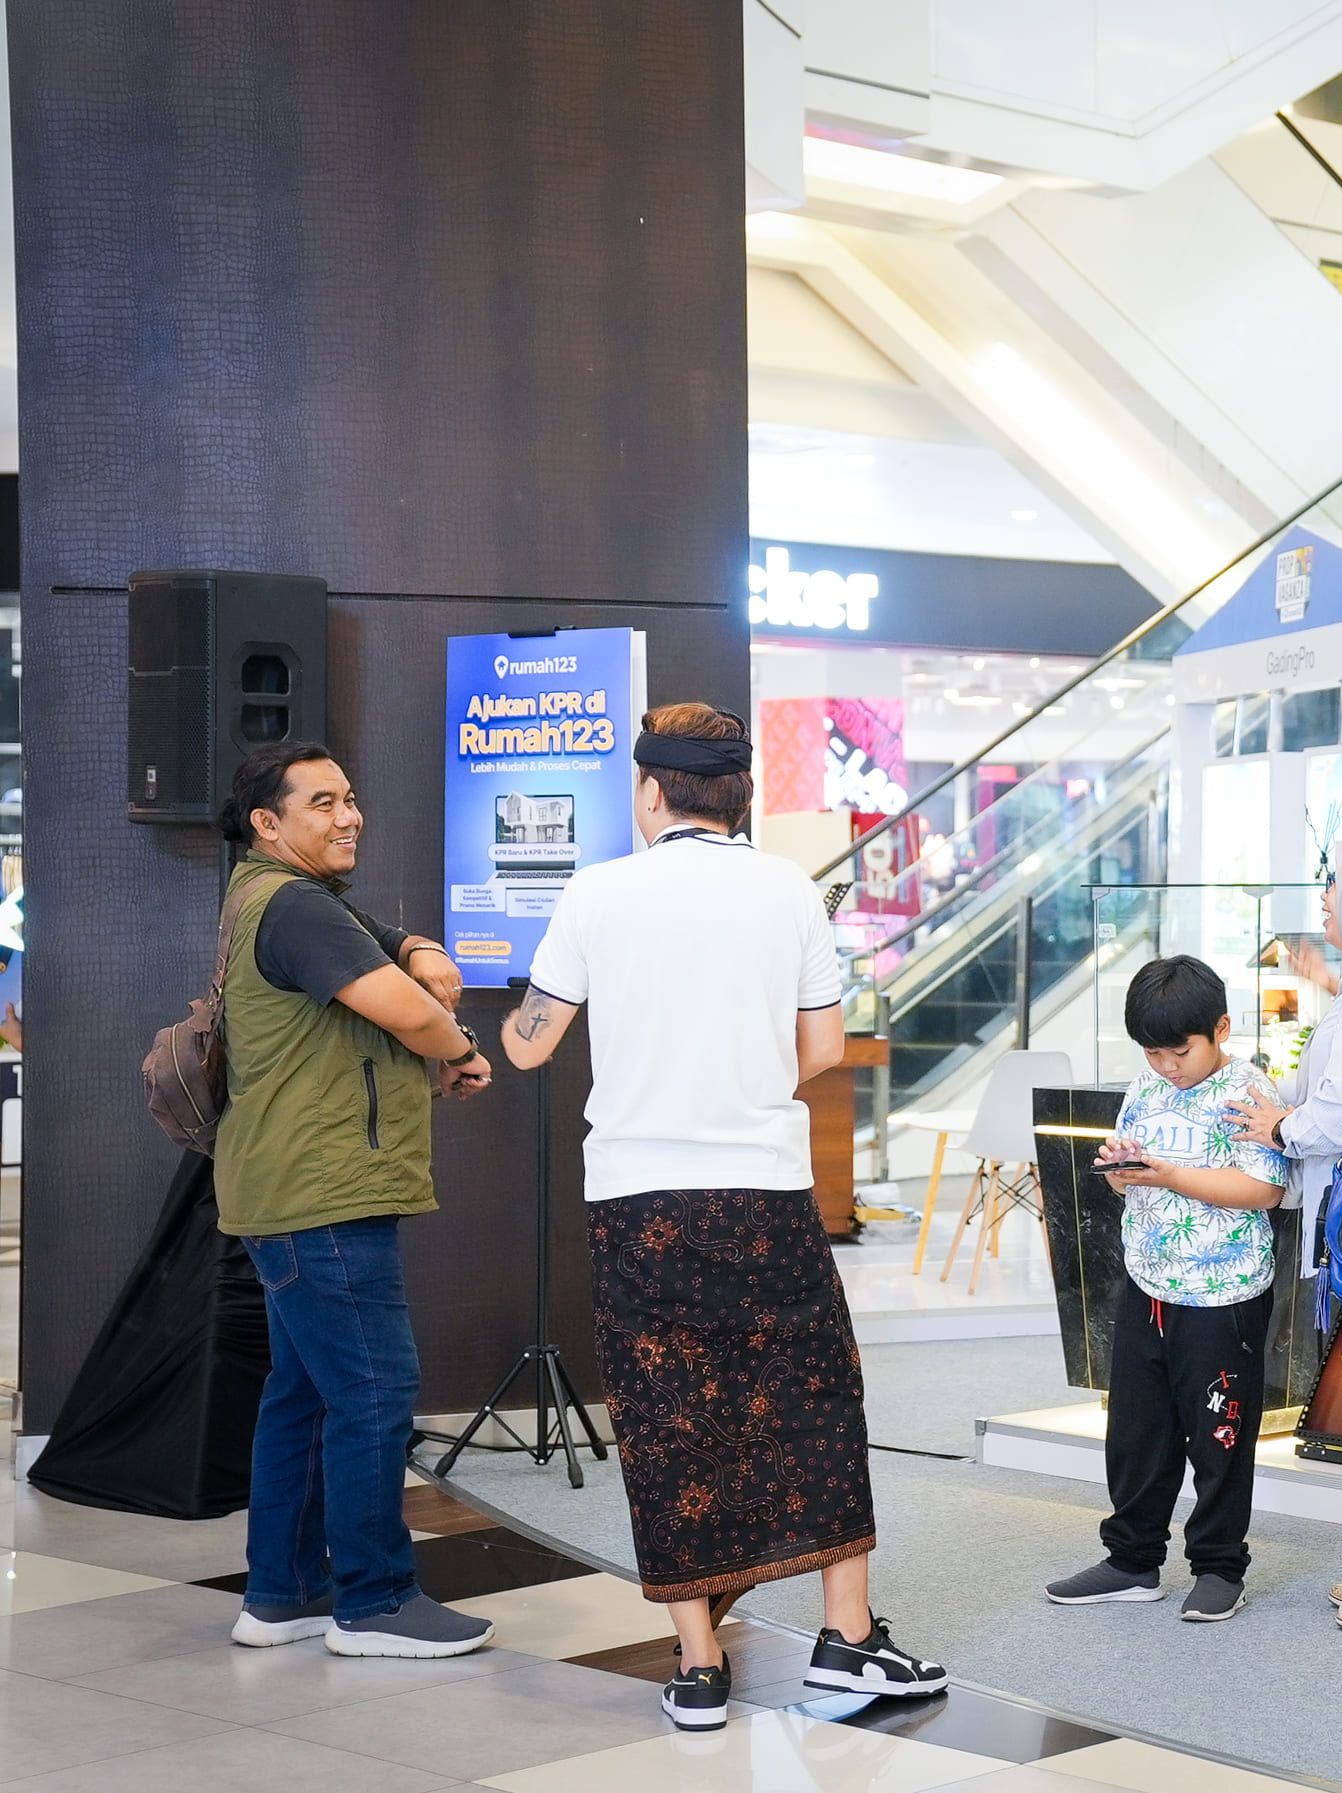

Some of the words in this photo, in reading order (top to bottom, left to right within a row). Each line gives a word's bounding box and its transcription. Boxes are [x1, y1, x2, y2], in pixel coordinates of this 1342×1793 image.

[509, 656, 577, 675] rumah123
[1266, 646, 1316, 676] GadingPro
[466, 694, 537, 722] Ajukan
[539, 691, 583, 715] KPR
[585, 690, 606, 713] di
[459, 719, 616, 755] Rumah123
[470, 761, 496, 773] Lebih
[496, 761, 528, 772] Mudah
[529, 761, 537, 771] &
[538, 760, 570, 771] Proses
[571, 759, 601, 772] Cepat
